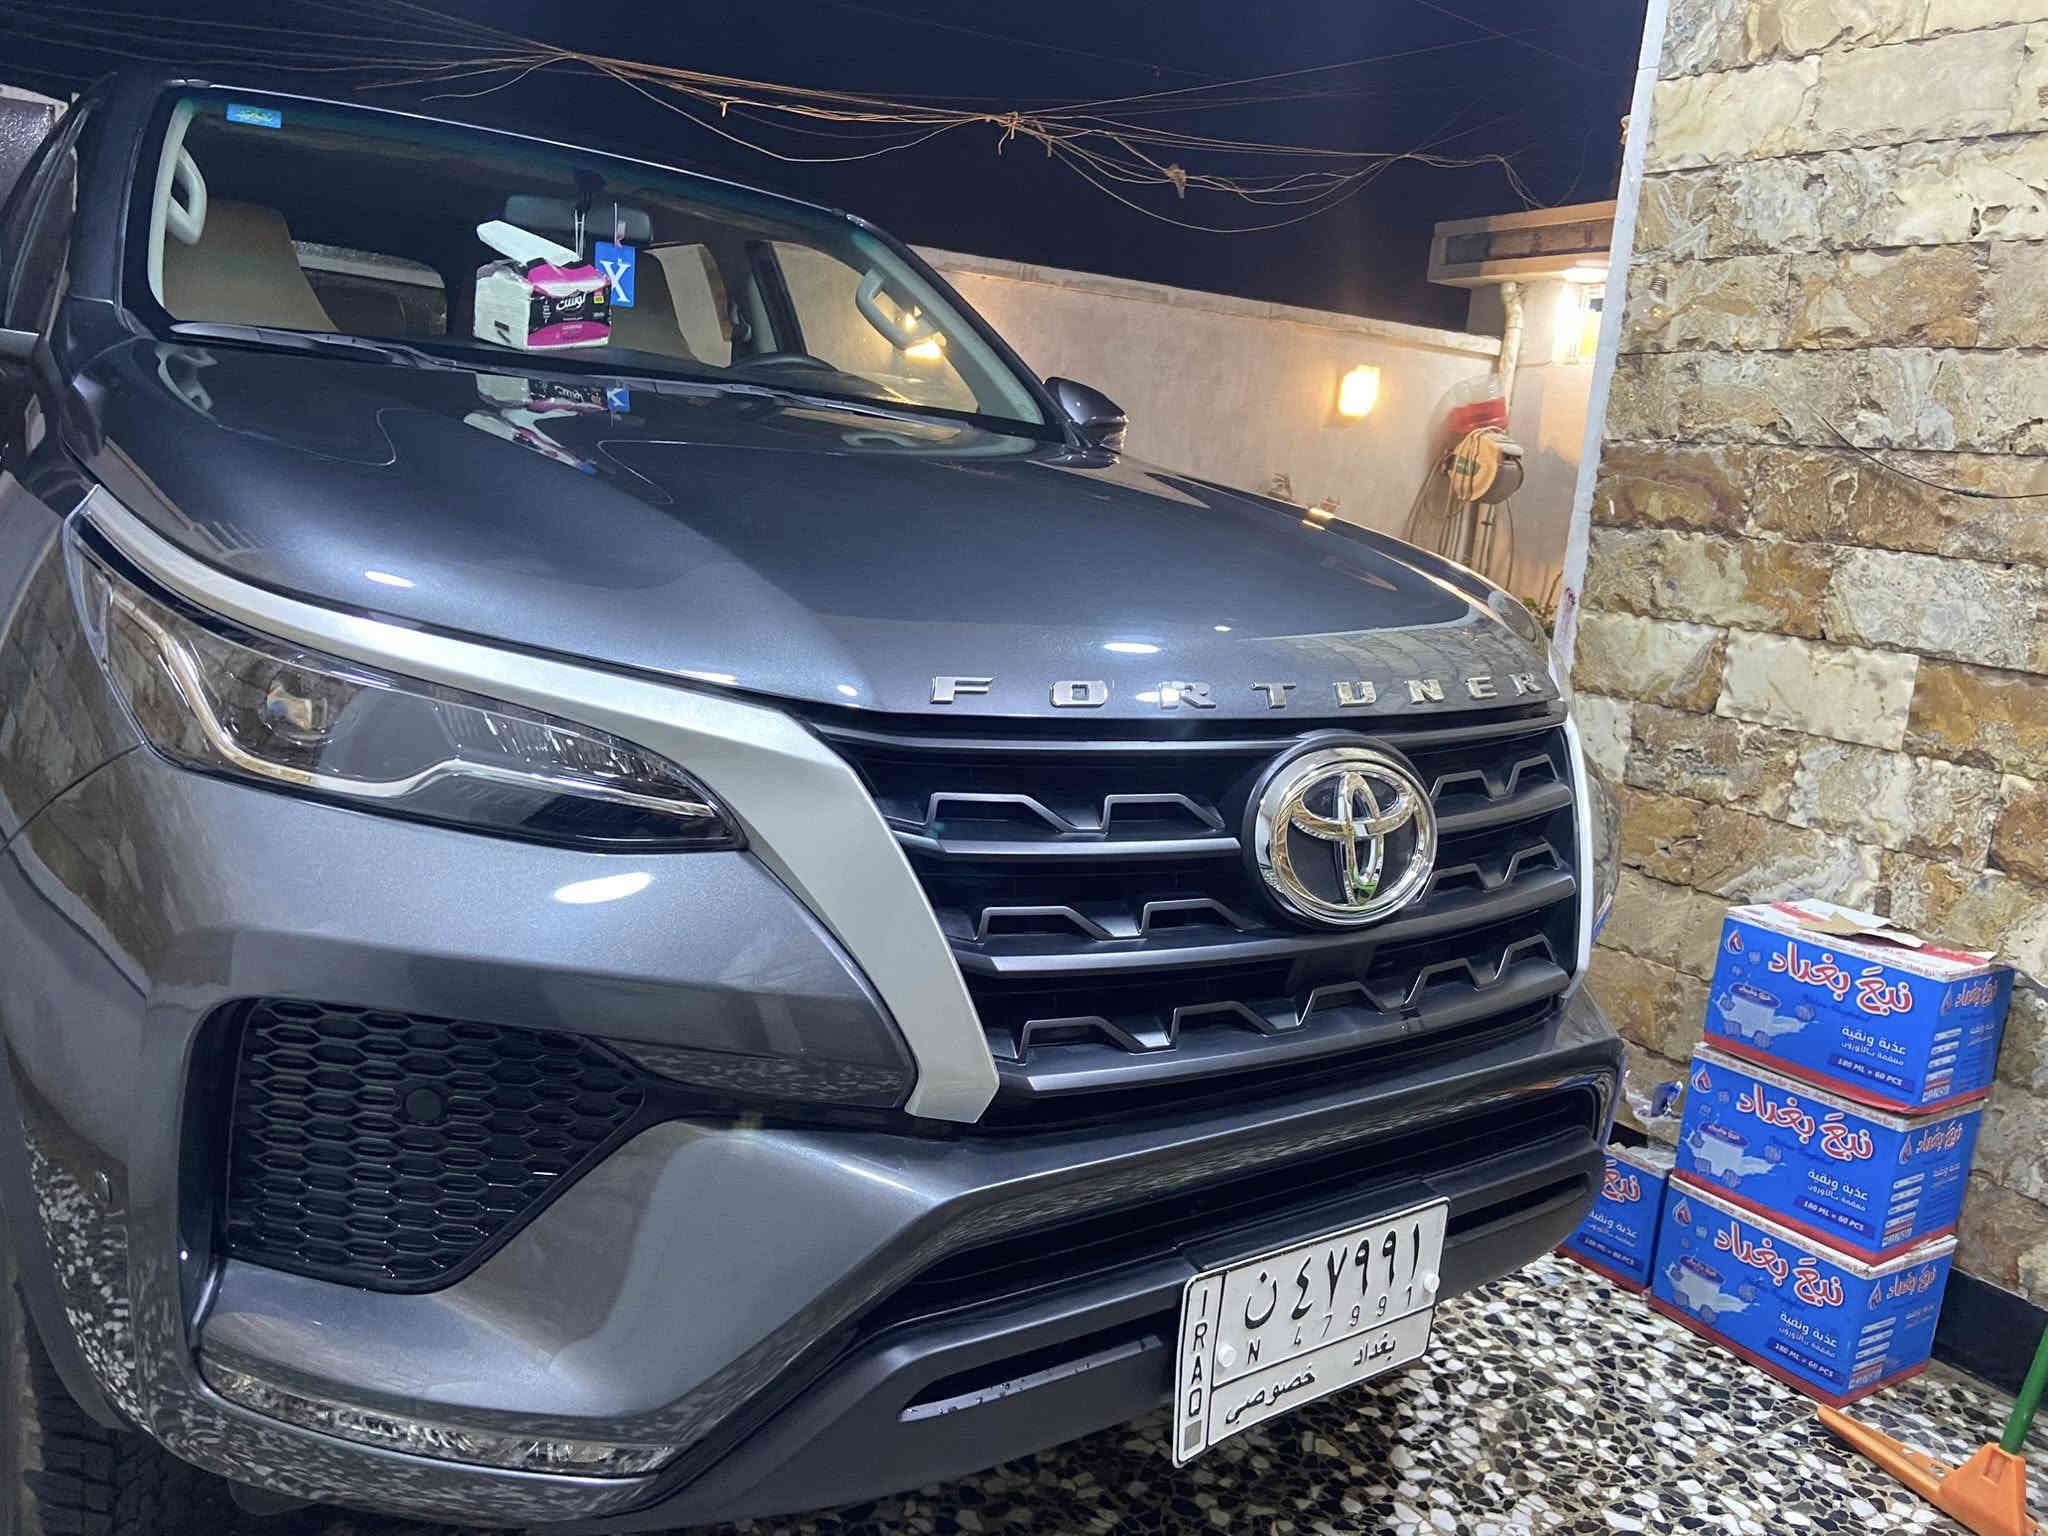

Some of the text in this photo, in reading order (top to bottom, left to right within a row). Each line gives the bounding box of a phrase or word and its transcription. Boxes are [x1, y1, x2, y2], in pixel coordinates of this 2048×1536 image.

[930, 671, 1543, 711] FORTUNER
[1768, 941, 1851, 1001] بغداد
[1736, 1083, 1815, 1145] بغداد
[1713, 1221, 1790, 1288] بغداد
[1188, 1289, 1208, 1416] IRAQ
[1225, 1332, 1397, 1425] بغداد خصوصي
